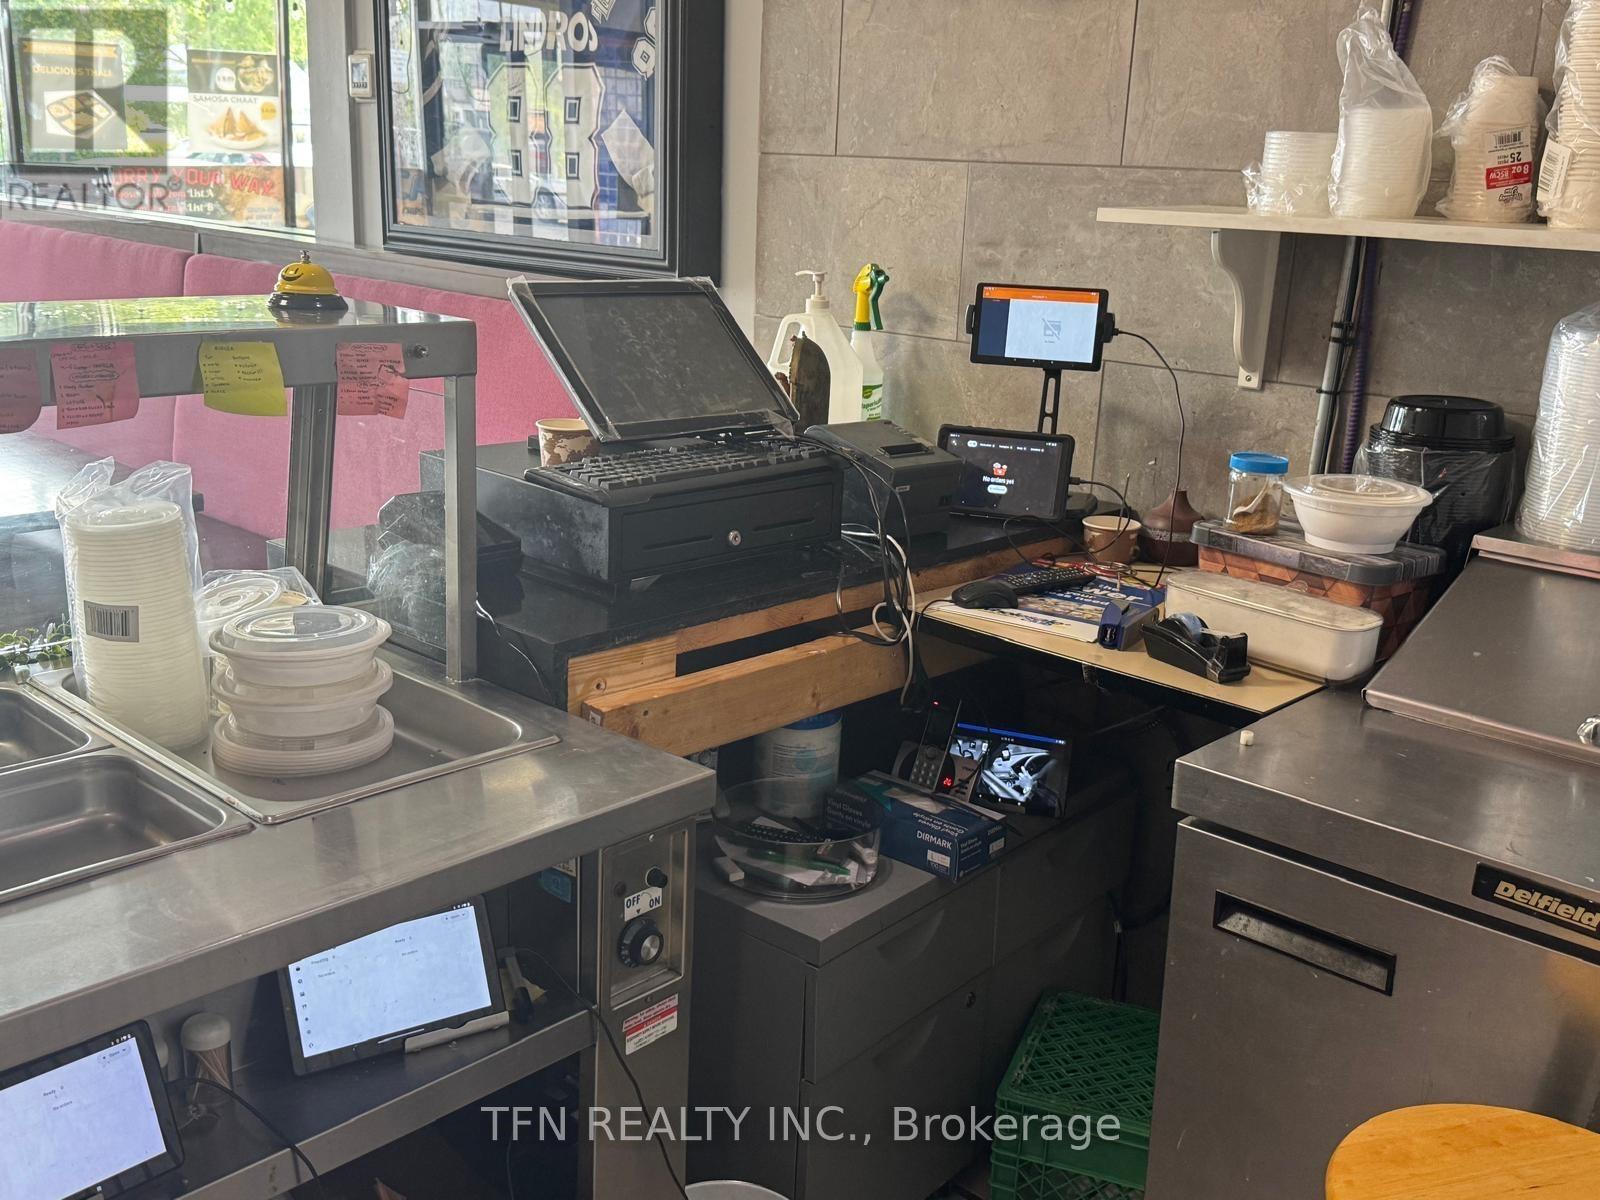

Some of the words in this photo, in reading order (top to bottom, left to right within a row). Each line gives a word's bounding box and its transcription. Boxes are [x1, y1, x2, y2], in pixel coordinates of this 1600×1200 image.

[193, 95, 229, 103] SAMOSA
[1509, 152, 1522, 163] 25
[231, 173, 274, 196] WAY
[916, 830, 952, 850] DIRMARK
[625, 894, 641, 909] OFF
[649, 895, 661, 908] ON
[1494, 880, 1600, 928] Delfield
